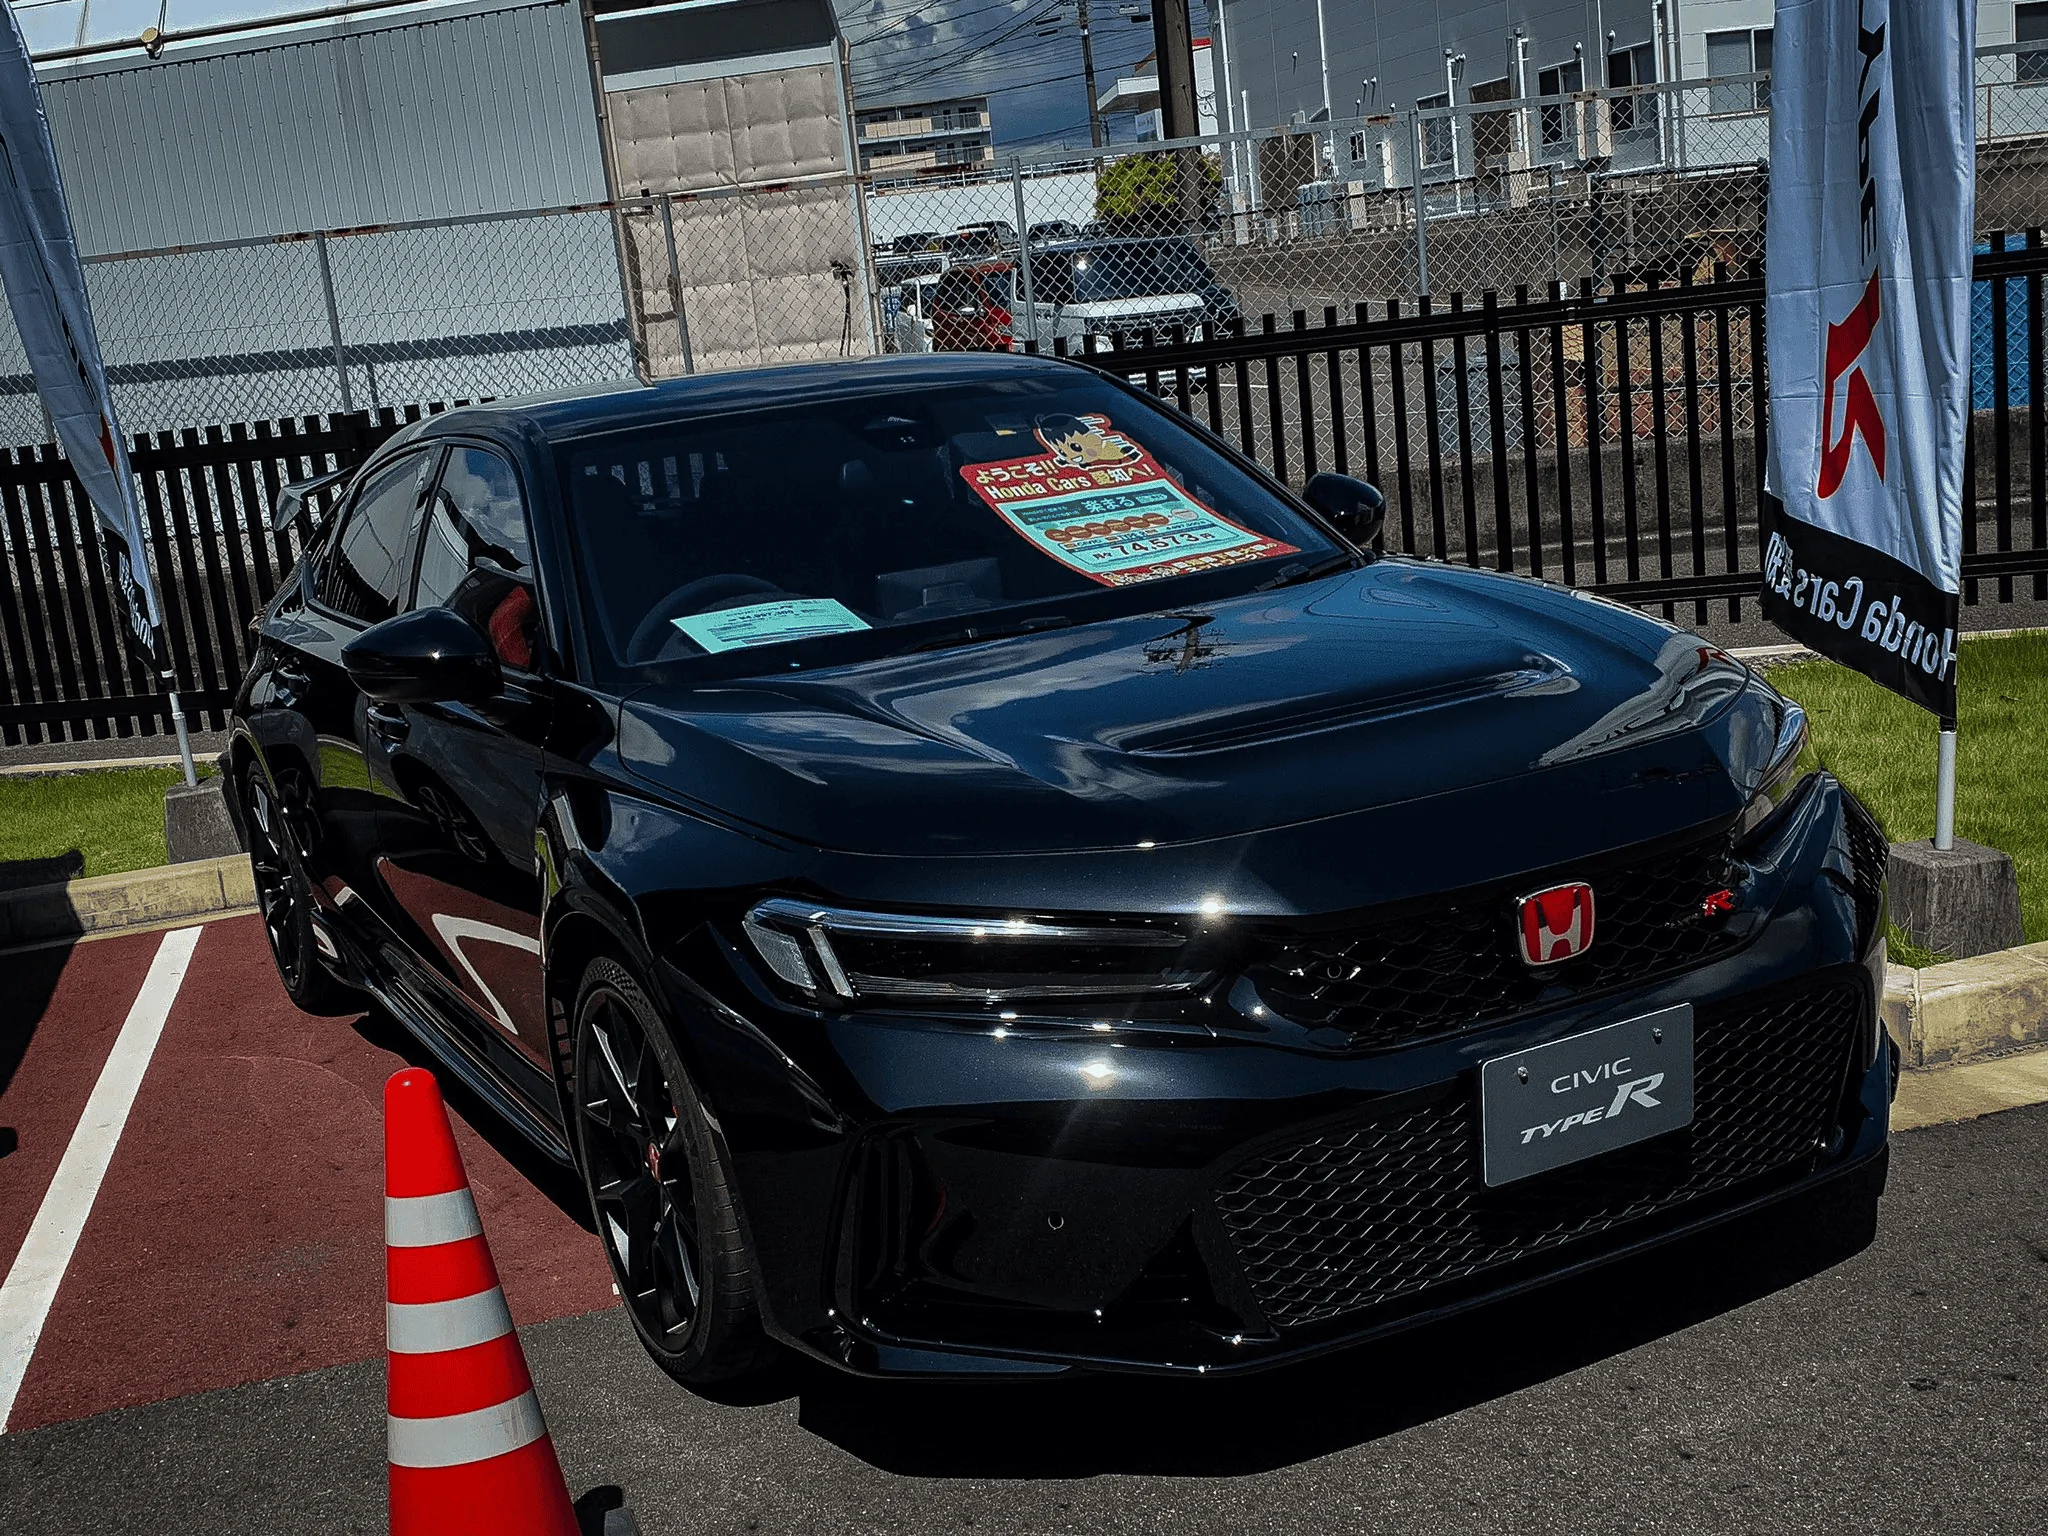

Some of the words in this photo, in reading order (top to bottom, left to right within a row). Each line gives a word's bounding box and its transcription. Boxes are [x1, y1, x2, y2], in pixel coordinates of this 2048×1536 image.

[984, 480, 1048, 500] Honda
[1046, 474, 1092, 492] Cars
[1111, 533, 1200, 555] 74,573
[1550, 1056, 1632, 1094] CIVIC
[1520, 1106, 1607, 1145] TYPE
[1604, 1072, 1666, 1119] R
